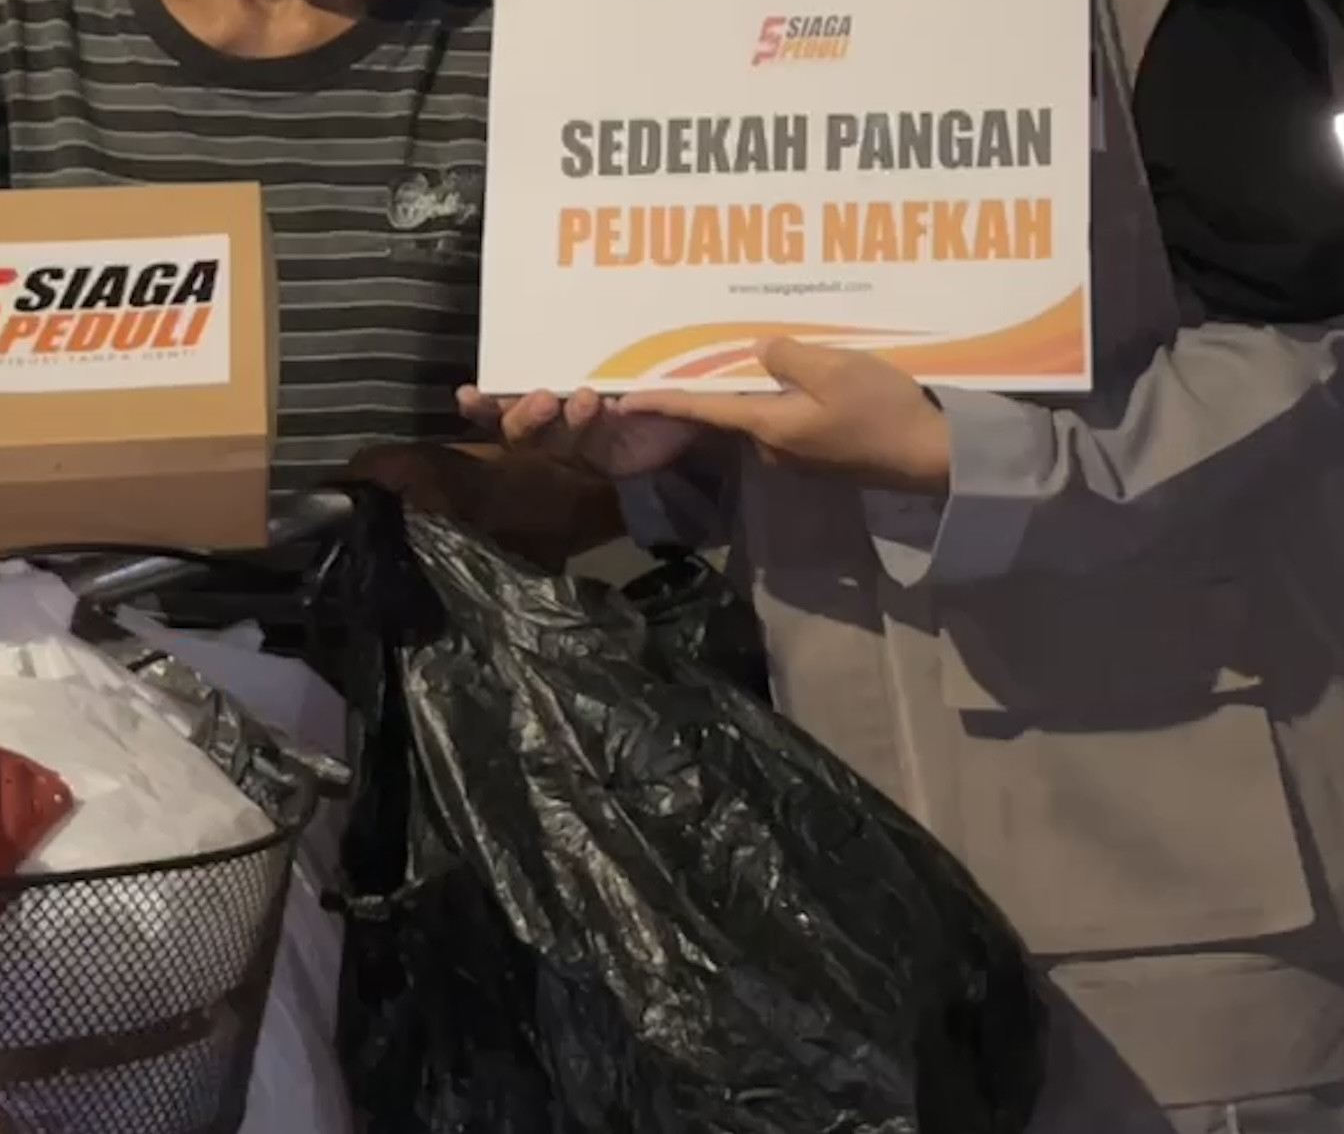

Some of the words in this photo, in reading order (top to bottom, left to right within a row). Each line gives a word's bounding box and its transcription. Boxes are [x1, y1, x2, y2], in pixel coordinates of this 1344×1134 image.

[782, 37, 850, 60] PEDULI
[786, 14, 852, 39] SIAGA
[560, 115, 808, 178] SEDEKAH
[826, 108, 1053, 172] PANGAN
[557, 203, 805, 268] PEJUANG
[822, 198, 1053, 263] NAFKAH
[14, 259, 219, 312] SIAGA
